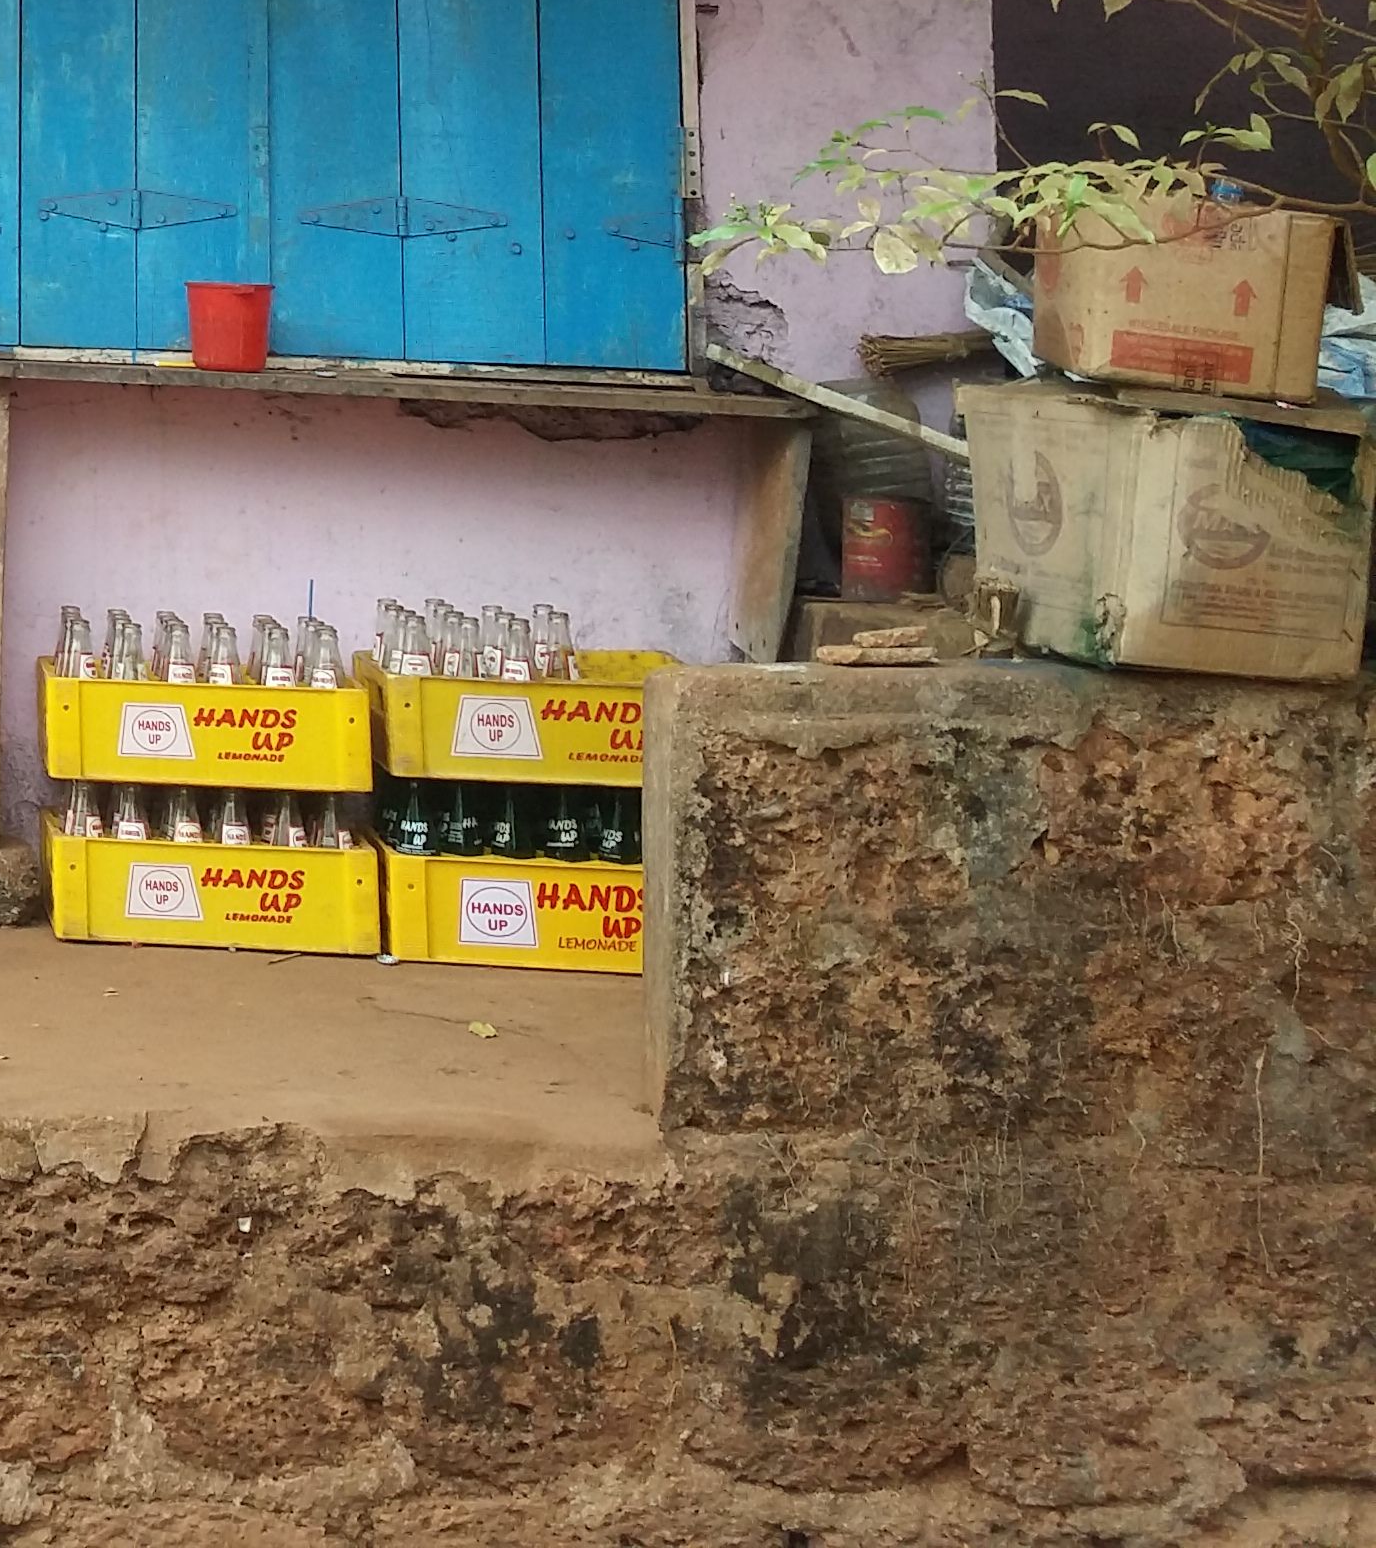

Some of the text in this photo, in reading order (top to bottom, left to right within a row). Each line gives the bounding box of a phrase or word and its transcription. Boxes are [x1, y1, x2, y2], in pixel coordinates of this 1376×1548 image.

[193, 707, 298, 729] HANDS
[540, 699, 643, 724] HAND
[138, 720, 171, 732] HANDS
[477, 713, 515, 728] HANDS
[148, 733, 162, 745] UP
[252, 732, 295, 751] UP
[489, 729, 503, 743] UP
[609, 728, 643, 751] U
[217, 751, 286, 763] LEMONADE
[569, 752, 643, 763] LEMONAD
[201, 867, 305, 890] HANDS
[145, 880, 179, 892] HANDS
[155, 894, 169, 905] UP
[260, 892, 302, 912] UP
[471, 902, 524, 916] HANDS
[225, 912, 293, 924] LEMONADE
[488, 919, 508, 931] UP
[602, 915, 643, 939] UP
[558, 936, 637, 952] LEMONADE
